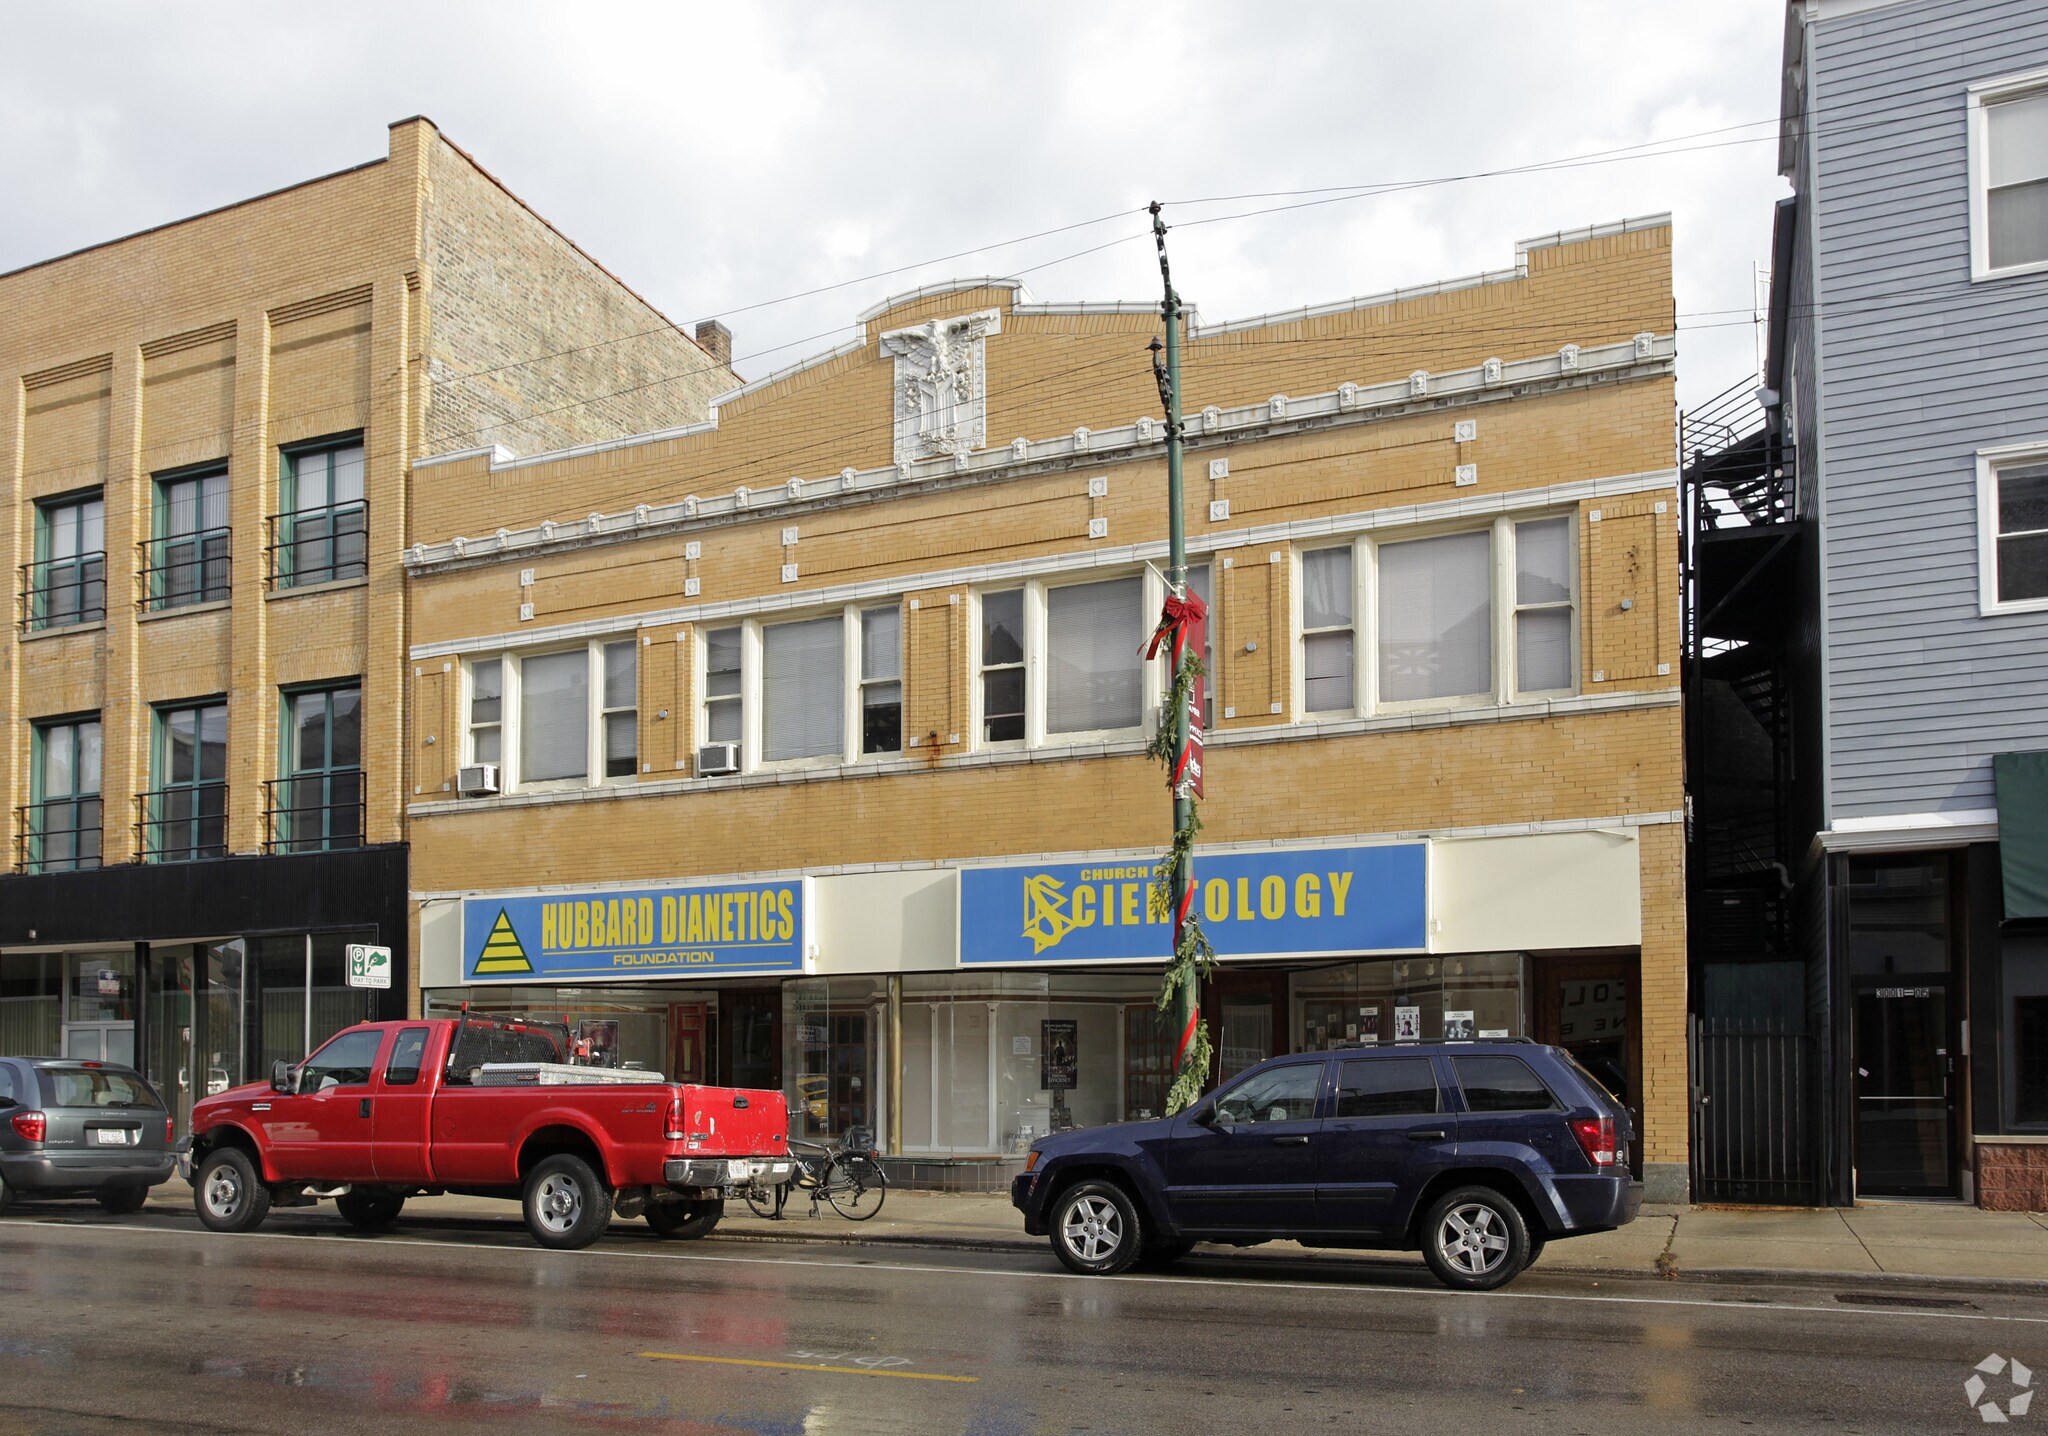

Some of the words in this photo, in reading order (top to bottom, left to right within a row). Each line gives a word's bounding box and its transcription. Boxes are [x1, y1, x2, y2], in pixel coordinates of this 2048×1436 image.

[1080, 866, 1149, 881] CHURCH
[542, 897, 654, 950] HUBBARD
[661, 889, 794, 944] DIANETICS
[613, 951, 715, 966] FOUNDATION
